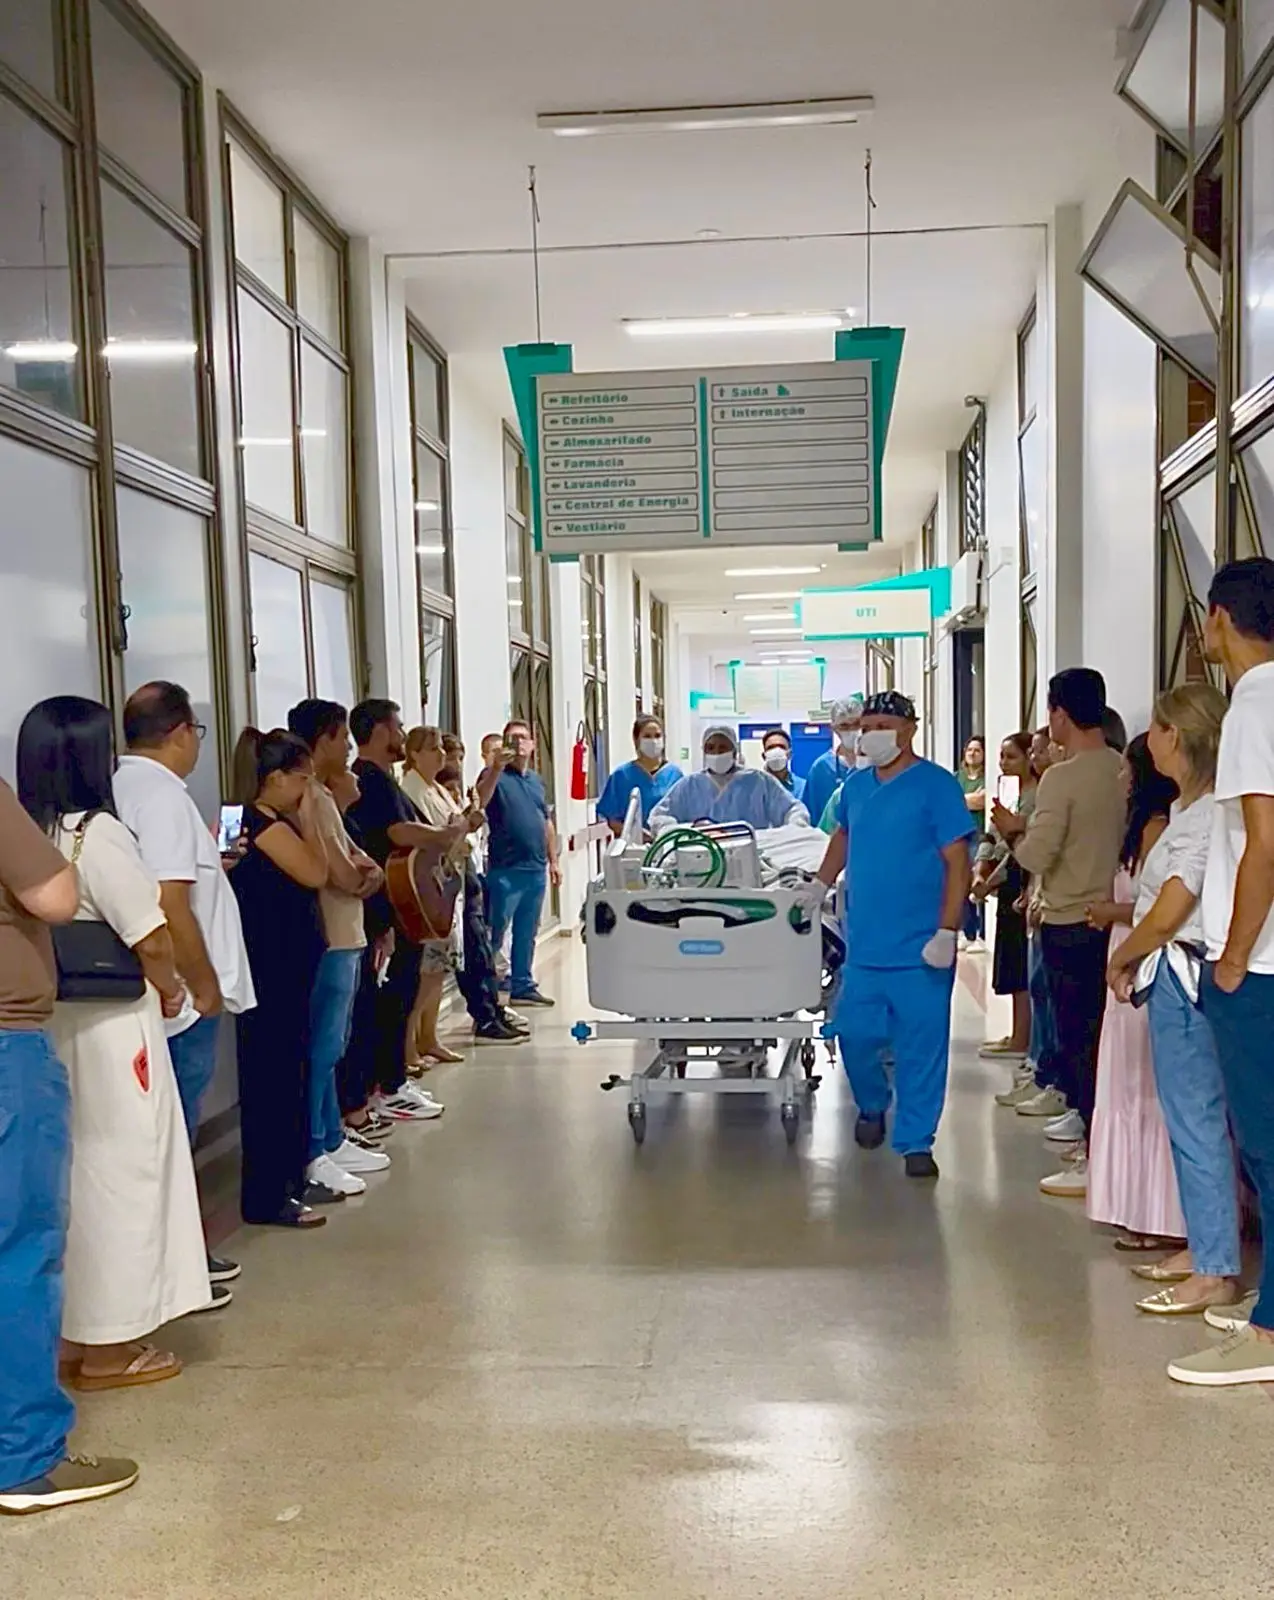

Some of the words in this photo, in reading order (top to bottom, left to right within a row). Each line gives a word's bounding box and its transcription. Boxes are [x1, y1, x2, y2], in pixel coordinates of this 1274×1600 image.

[731, 386, 769, 398] Saída
[560, 392, 629, 405] Refeitório
[731, 406, 806, 418] Internação
[562, 414, 614, 425] Cozinha
[563, 434, 652, 447] Almoxarifado
[563, 457, 625, 469] Farmácia
[563, 477, 636, 490] Lavanderia
[565, 499, 614, 510] Central
[618, 497, 634, 509] de
[639, 495, 689, 509] Energia
[566, 521, 626, 533] Vestiário
[856, 607, 877, 618] UTI
